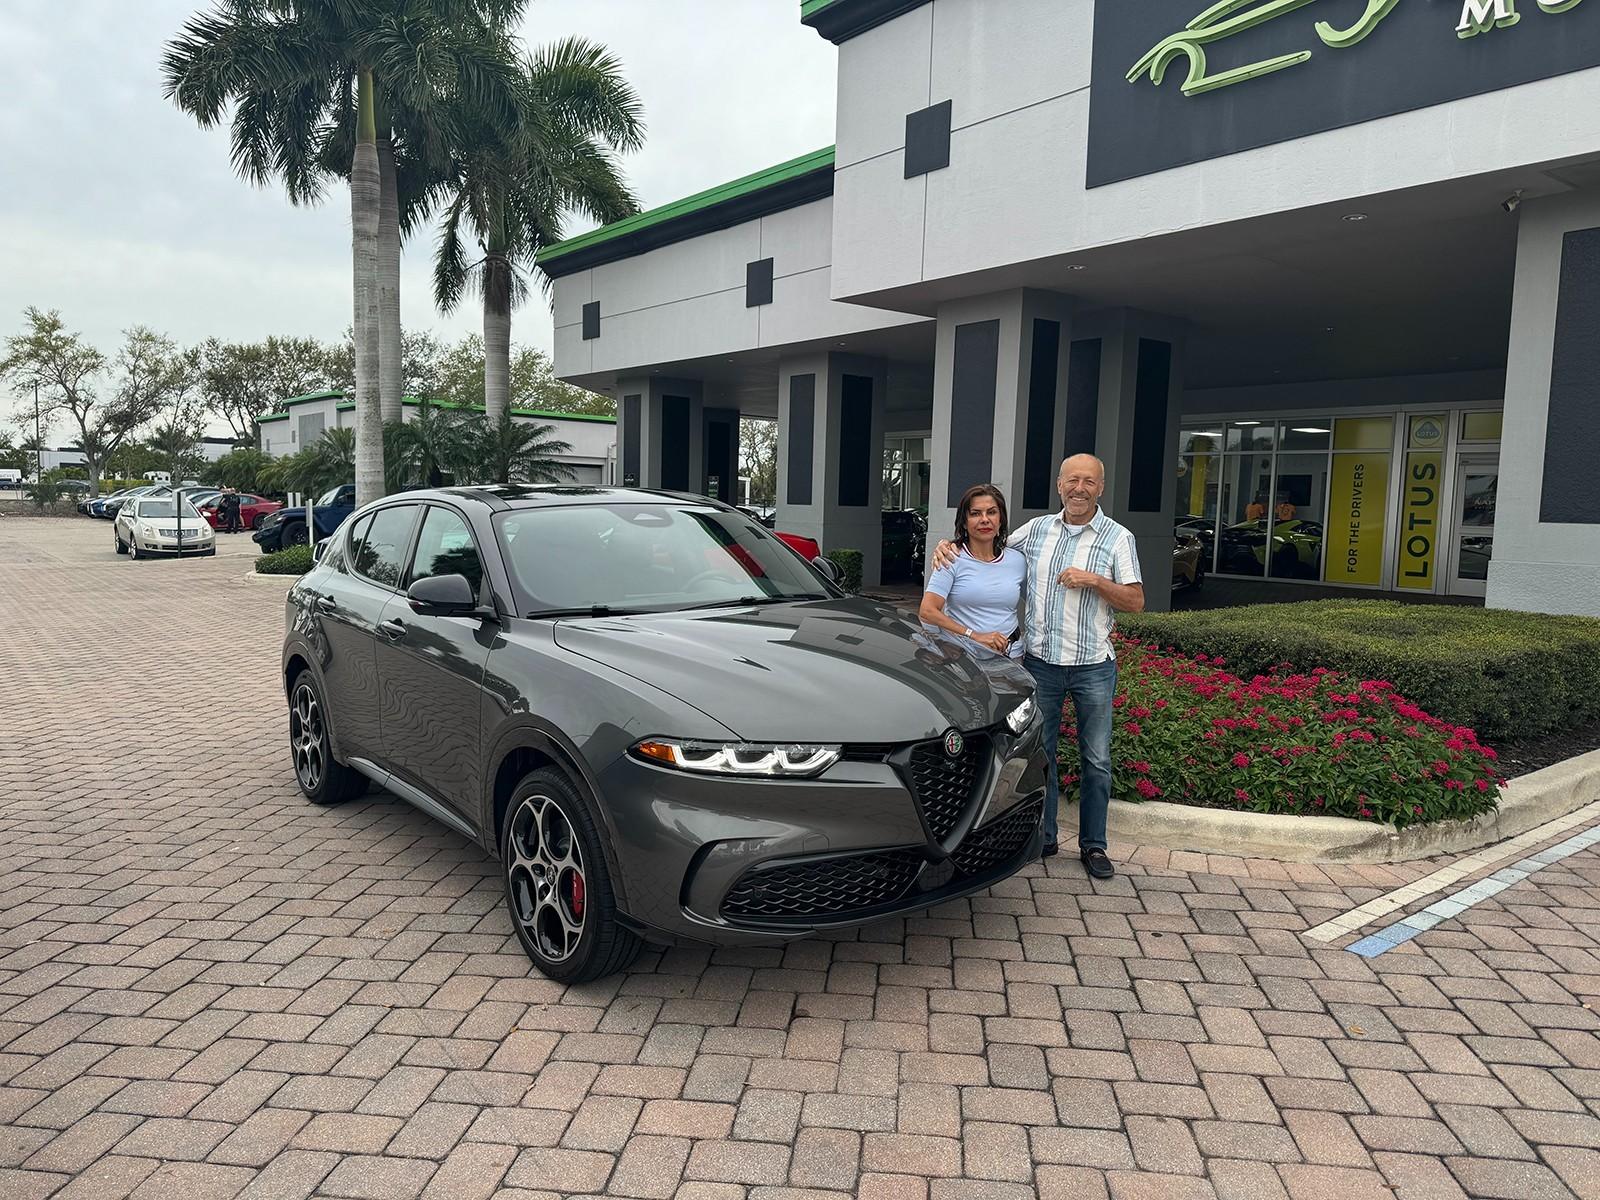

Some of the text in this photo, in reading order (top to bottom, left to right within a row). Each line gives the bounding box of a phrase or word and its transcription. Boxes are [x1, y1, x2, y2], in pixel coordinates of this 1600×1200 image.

[1347, 463, 1364, 573] FOR THE DRIVERS
[1405, 463, 1436, 578] LOTUS
